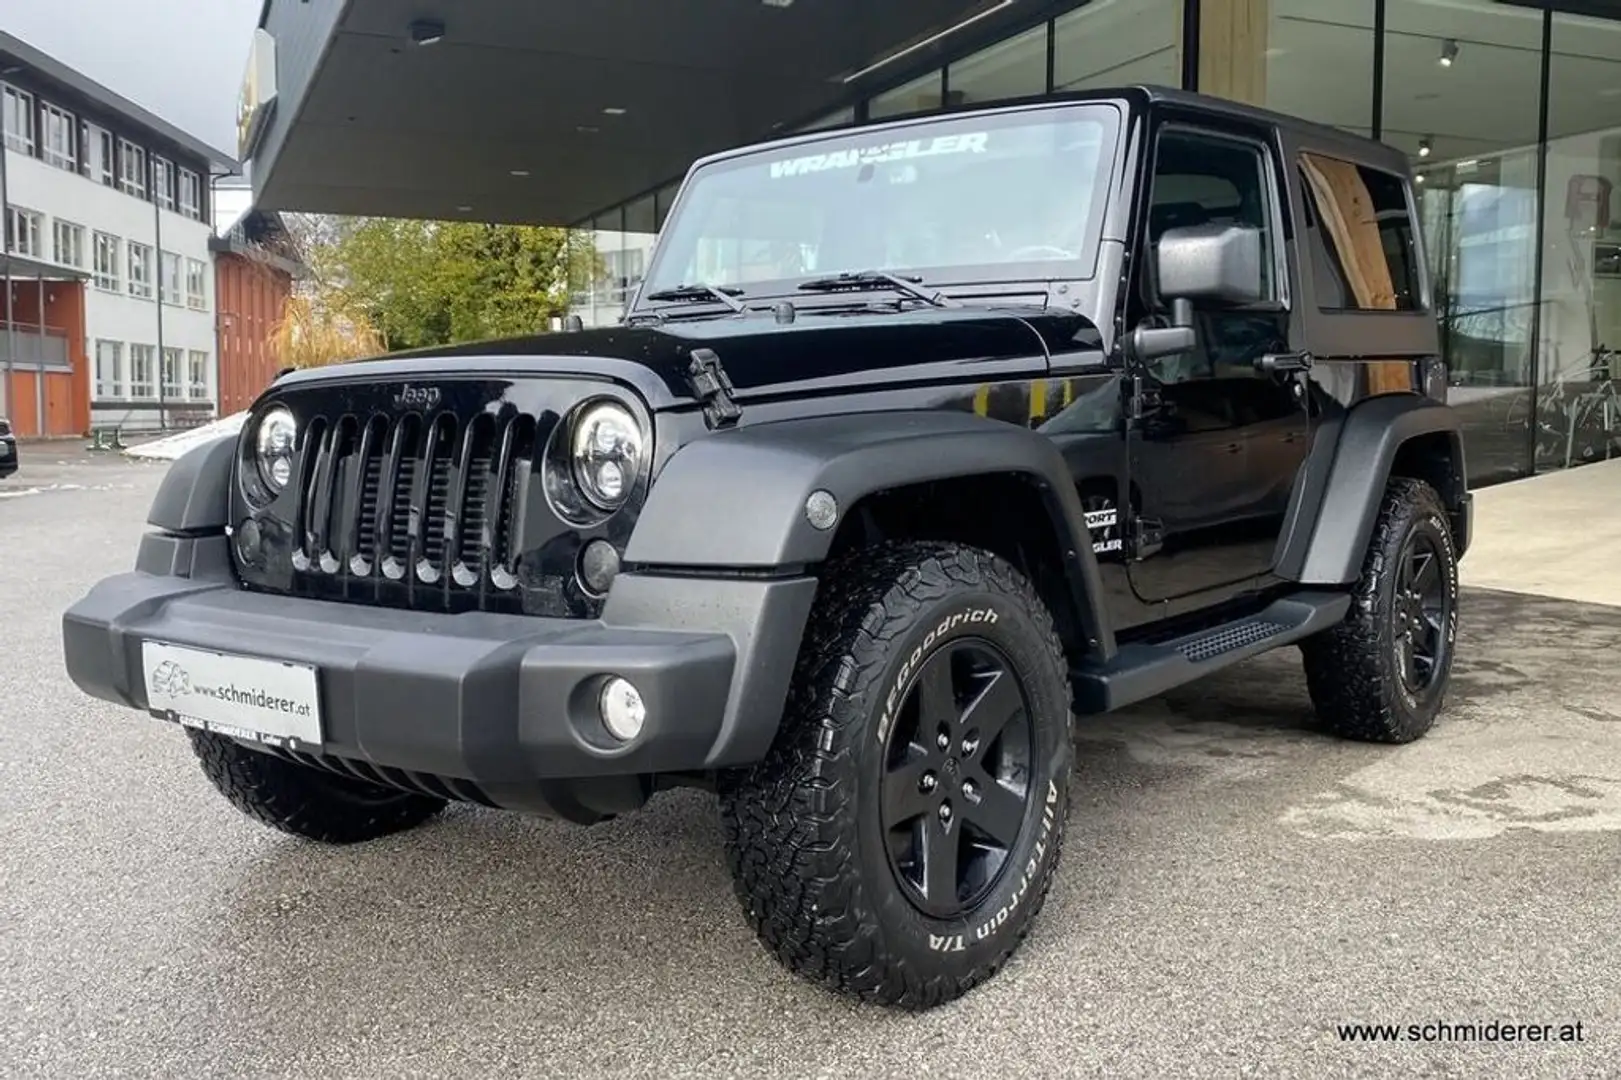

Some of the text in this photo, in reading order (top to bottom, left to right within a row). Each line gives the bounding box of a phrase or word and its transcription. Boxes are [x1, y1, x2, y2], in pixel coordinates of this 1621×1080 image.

[392, 383, 441, 411] Jeep
[193, 684, 311, 717] www.schmiderer.at
[929, 933, 966, 952] T/A
